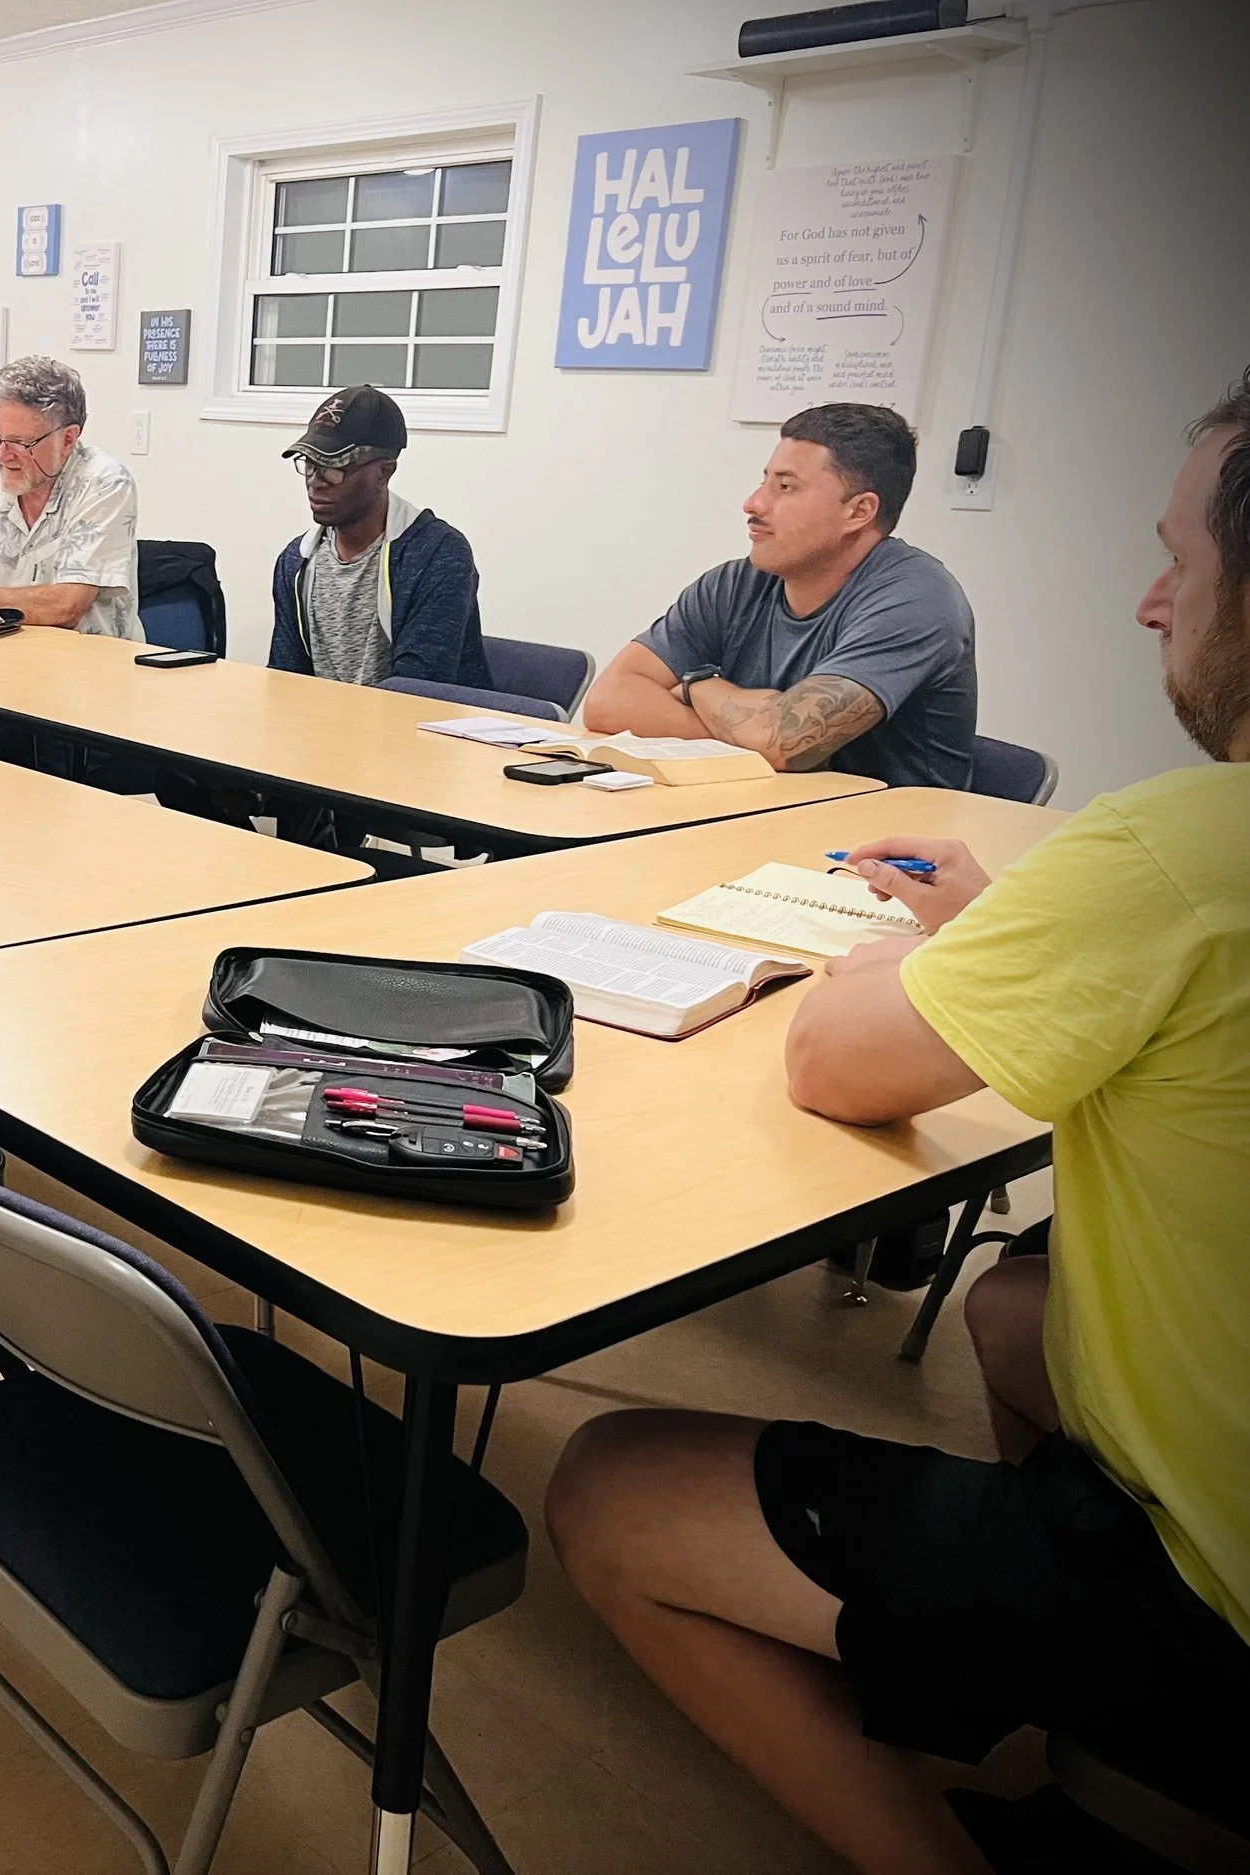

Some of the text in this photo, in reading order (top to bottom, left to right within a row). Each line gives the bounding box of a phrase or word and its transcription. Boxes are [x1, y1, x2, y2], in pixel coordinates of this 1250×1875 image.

[594, 147, 704, 214] HAL
[780, 224, 905, 242] For God has not given
[776, 246, 915, 267] us a spirit of fear, but of
[81, 271, 100, 287] Call
[773, 275, 873, 293] power and of love
[769, 301, 790, 314] and
[793, 300, 807, 314] of
[807, 304, 813, 313] a
[816, 300, 851, 313] sound
[150, 315, 174, 328] IN HIS
[577, 282, 691, 349] JAH
[143, 327, 181, 340] PRESENCE
[146, 339, 177, 351] THERE IS
[144, 351, 178, 362] FULLNESS
[147, 362, 174, 373] OF JOY
